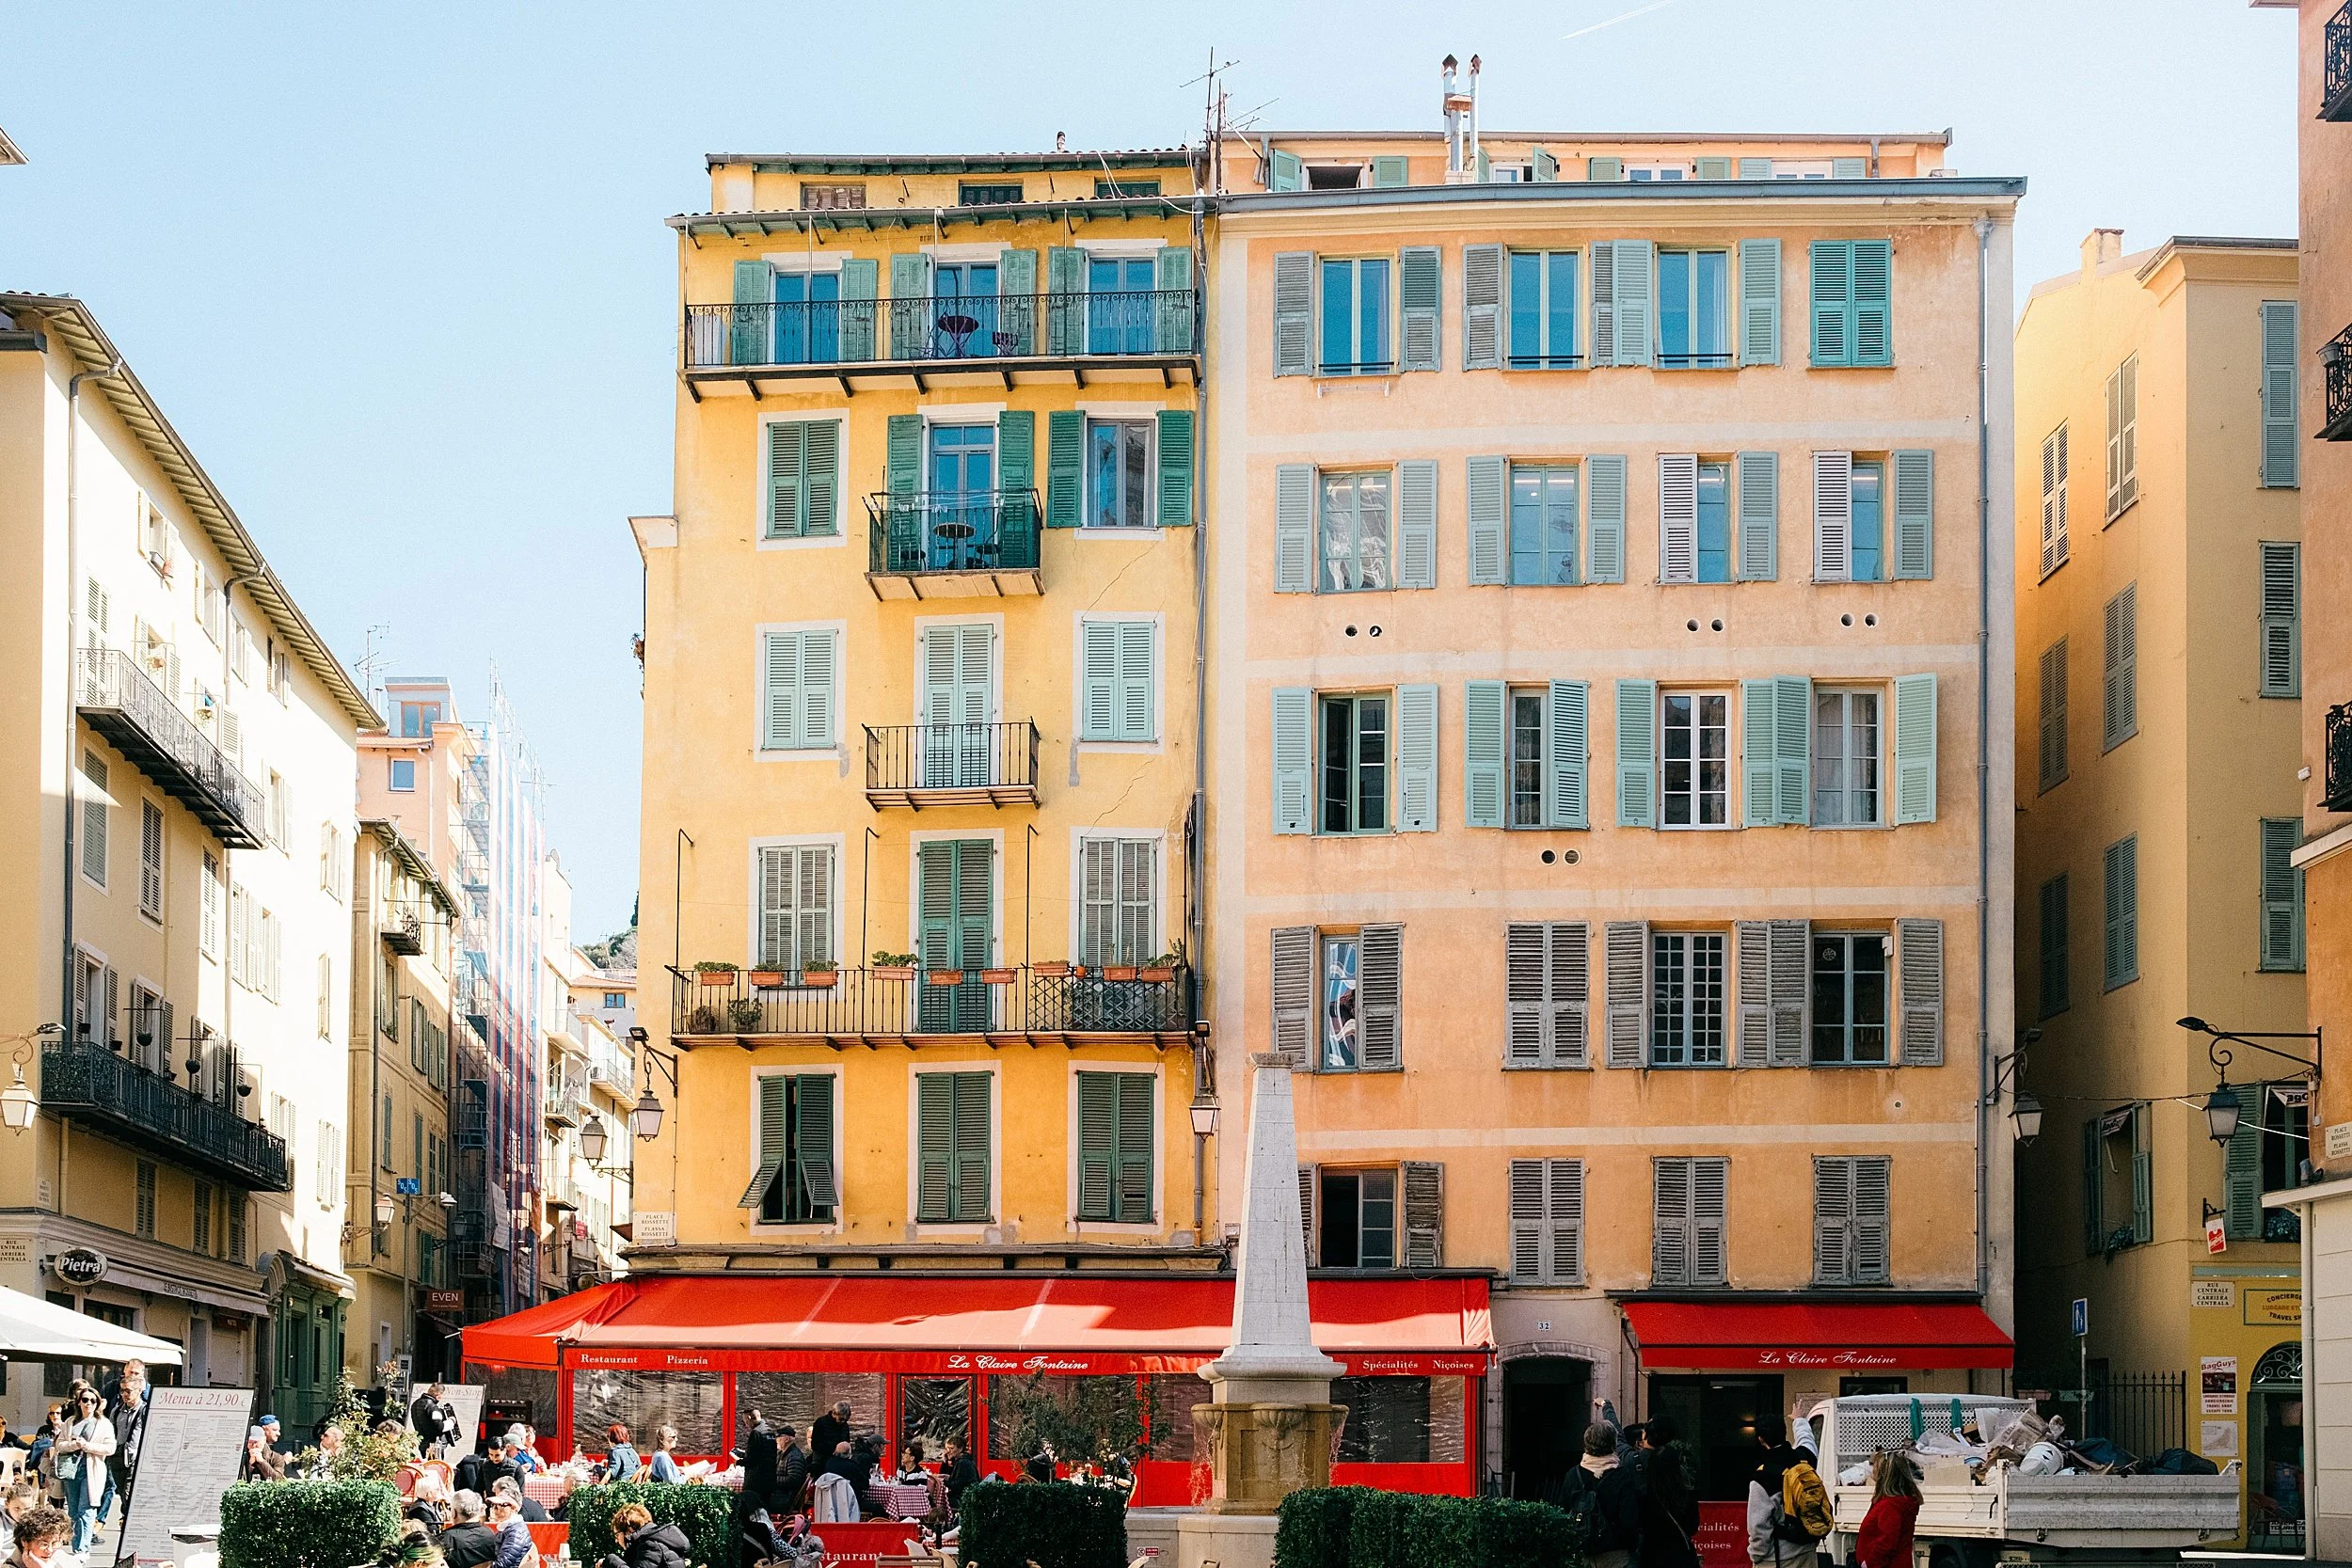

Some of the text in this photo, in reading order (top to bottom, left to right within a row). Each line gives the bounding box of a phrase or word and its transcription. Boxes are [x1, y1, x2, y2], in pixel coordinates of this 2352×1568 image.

[2287, 1092, 2308, 1103] agG
[2331, 1132, 2350, 1141] ROSSETTI
[2331, 1147, 2350, 1155] ROSSETTI
[60, 1257, 102, 1273] Pietra
[432, 1292, 459, 1302] EVEN
[2269, 1311, 2293, 1322] TRAVEL
[580, 1354, 638, 1364] Restaurant
[666, 1354, 708, 1365] Pizzeria
[947, 1354, 1089, 1370] La Claire Fontaine
[1758, 1351, 1897, 1364] La Claire Fontaine
[1362, 1359, 1474, 1371] Spécialités Niçoises
[2201, 1359, 2236, 1370] BagGuys
[158, 1392, 192, 1405] Menu
[195, 1392, 203, 1405] à
[205, 1393, 239, 1406] 21,90
[1697, 1522, 1740, 1531] cialités
[1693, 1540, 1732, 1551] içoises
